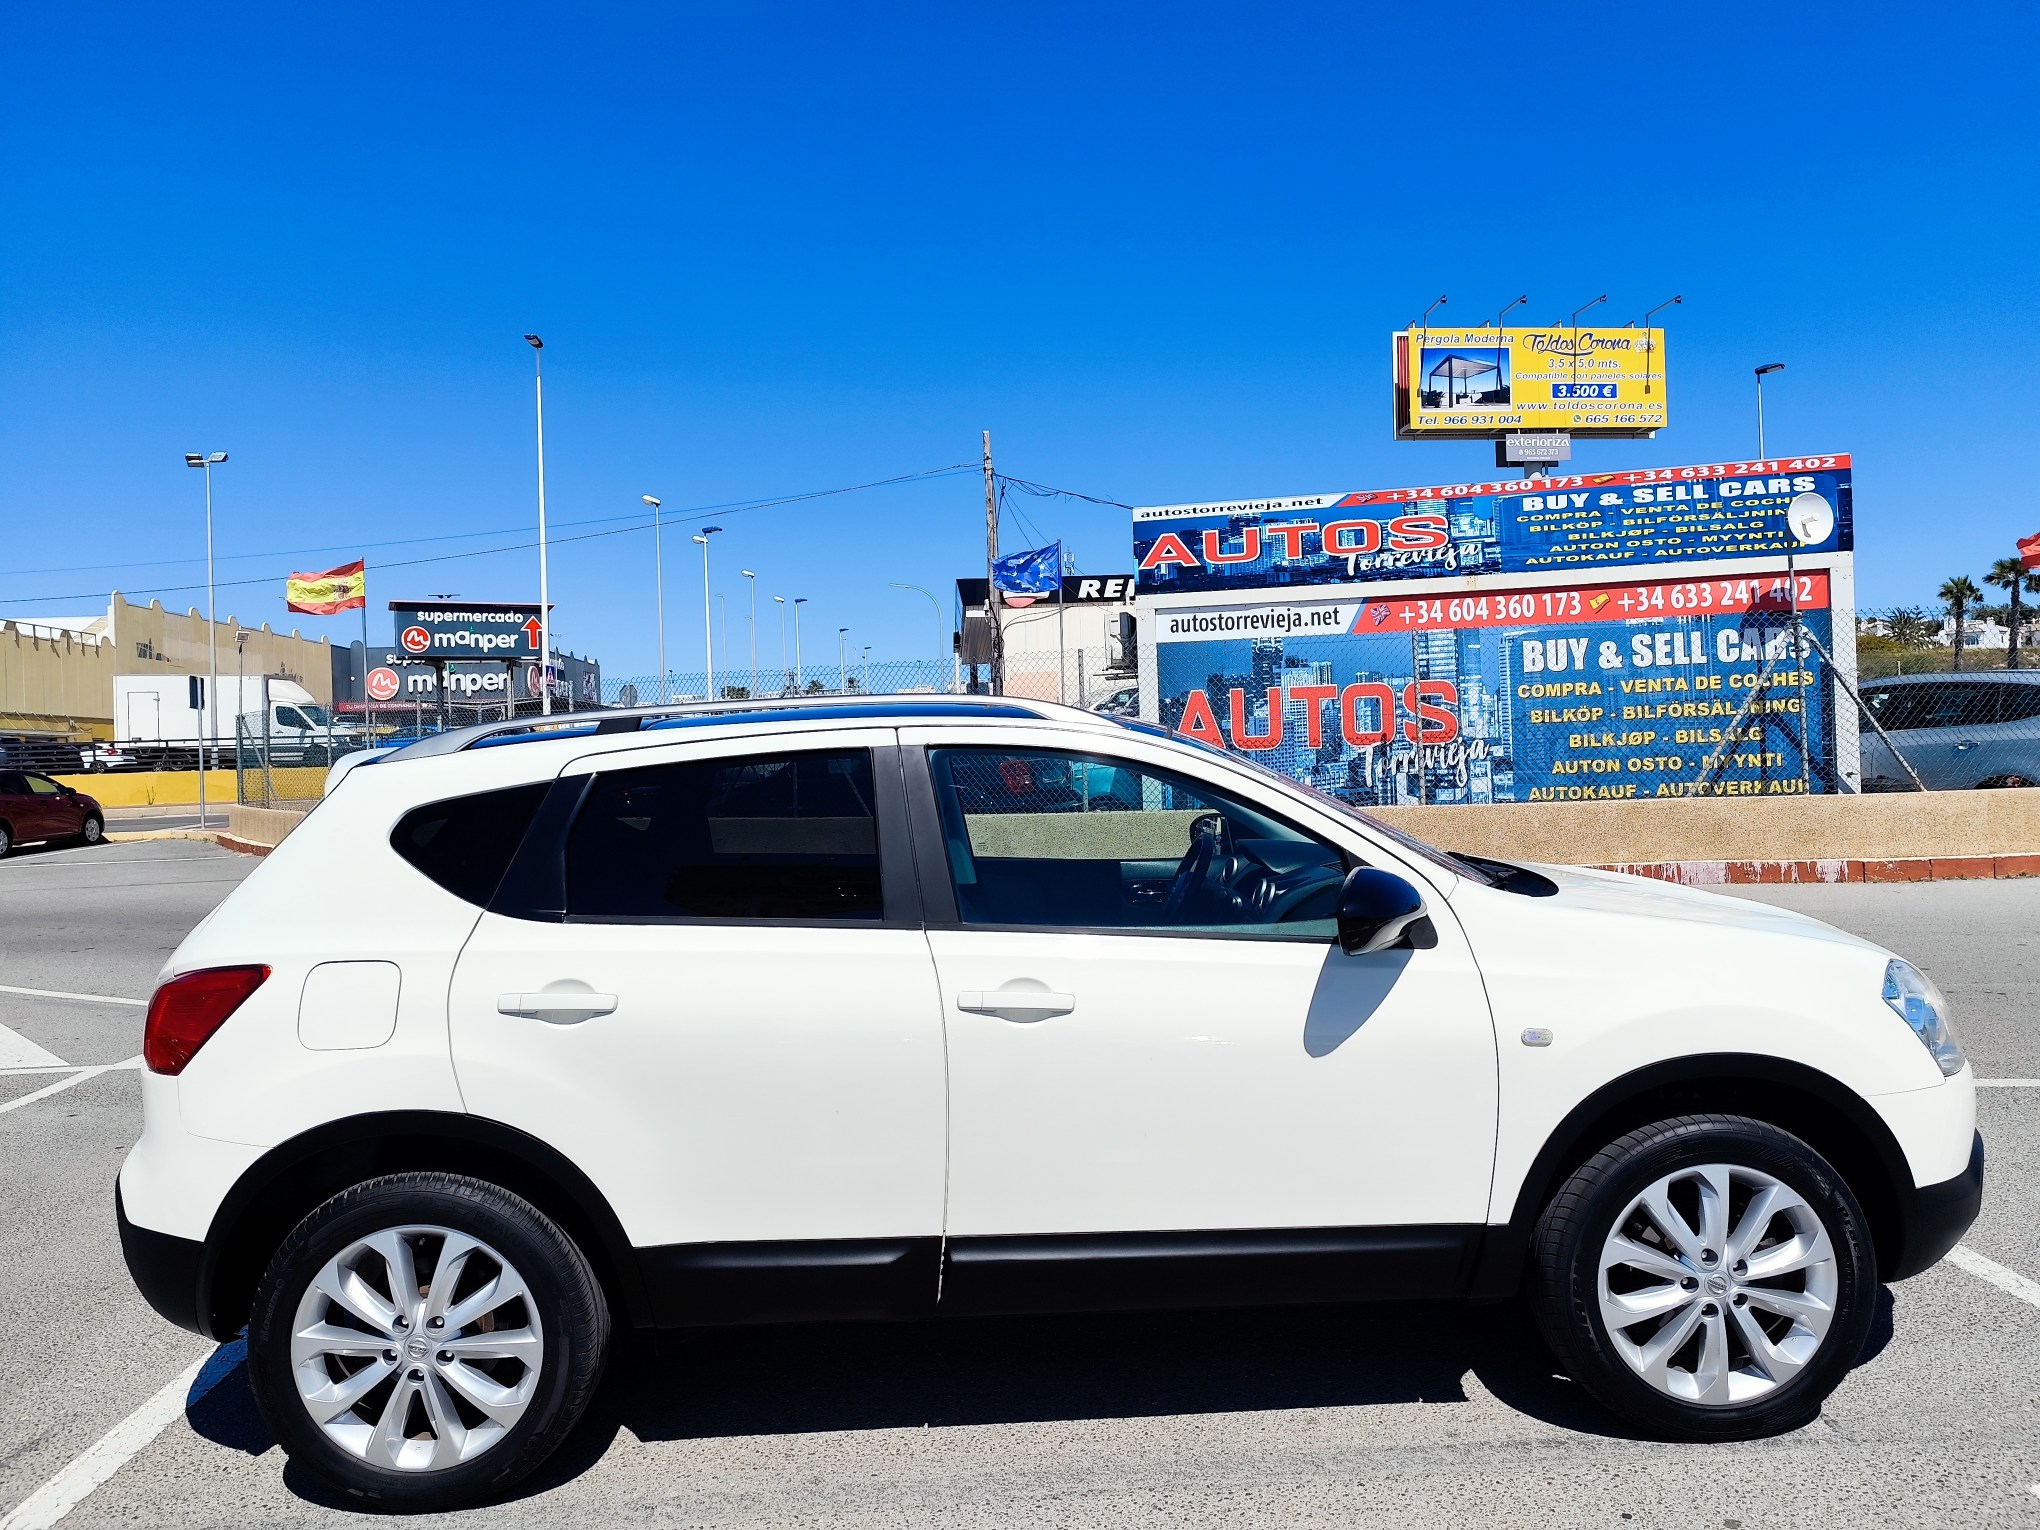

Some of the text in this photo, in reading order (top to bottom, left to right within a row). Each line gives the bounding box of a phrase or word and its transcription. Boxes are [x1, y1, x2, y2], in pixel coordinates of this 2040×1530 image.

[1464, 333, 1514, 343] Moderna
[1523, 332, 1631, 354] Toldos Corona
[1548, 358, 1565, 369] 3,5
[1578, 358, 1595, 369] 5,0
[1597, 359, 1621, 368] mts.
[1515, 372, 1568, 381] Compatible
[1557, 385, 1613, 397] 3.500 €
[1516, 401, 1663, 410] www.toldoscorona.es
[1418, 415, 1522, 425] Tel. 966 931 004
[1585, 415, 1662, 423] 665 166 572
[1506, 436, 1570, 447] exterioriza
[1623, 456, 1837, 483] +34 633 241 402
[1387, 476, 1584, 502] +34 604 360 173
[1522, 475, 1816, 512] BUY & SELL CARS
[1140, 498, 1324, 519] autostorrevieja.net
[1516, 510, 1602, 522] COMPRA
[1620, 504, 1690, 515] VENTA
[1696, 502, 1724, 510] DE
[1529, 521, 1603, 533] BILKÖP
[1568, 528, 1656, 541] BILKJØP
[1675, 521, 1765, 533] BILSALG
[1138, 514, 1452, 570] AUTOS
[1549, 541, 1619, 553] AUTON
[1626, 537, 1682, 547] OSTO
[1701, 531, 1784, 543] MYYNTI
[1345, 541, 1482, 576] Torrevieja
[1525, 551, 1635, 565] AUTOKAUF
[1617, 576, 1813, 613] +34 633 241 402
[416, 610, 524, 625] supermercado
[1399, 591, 1581, 625] +34 604 360 173
[1170, 606, 1341, 634] autostorrevieja.net
[1522, 637, 1590, 673] BUY
[1598, 640, 1623, 668] &
[1630, 631, 1709, 668] SELL
[1517, 681, 1602, 698] COMPRA
[1620, 677, 1689, 694] VENTA
[1695, 675, 1722, 690] DE
[1177, 678, 1459, 751] AUTOS
[1530, 705, 1604, 724] BILKÖP
[1569, 731, 1656, 748] BILKJØP
[1552, 759, 1621, 775] AUTON
[1627, 757, 1682, 772] OSTO
[1529, 784, 1637, 801] AUTOKAUF
